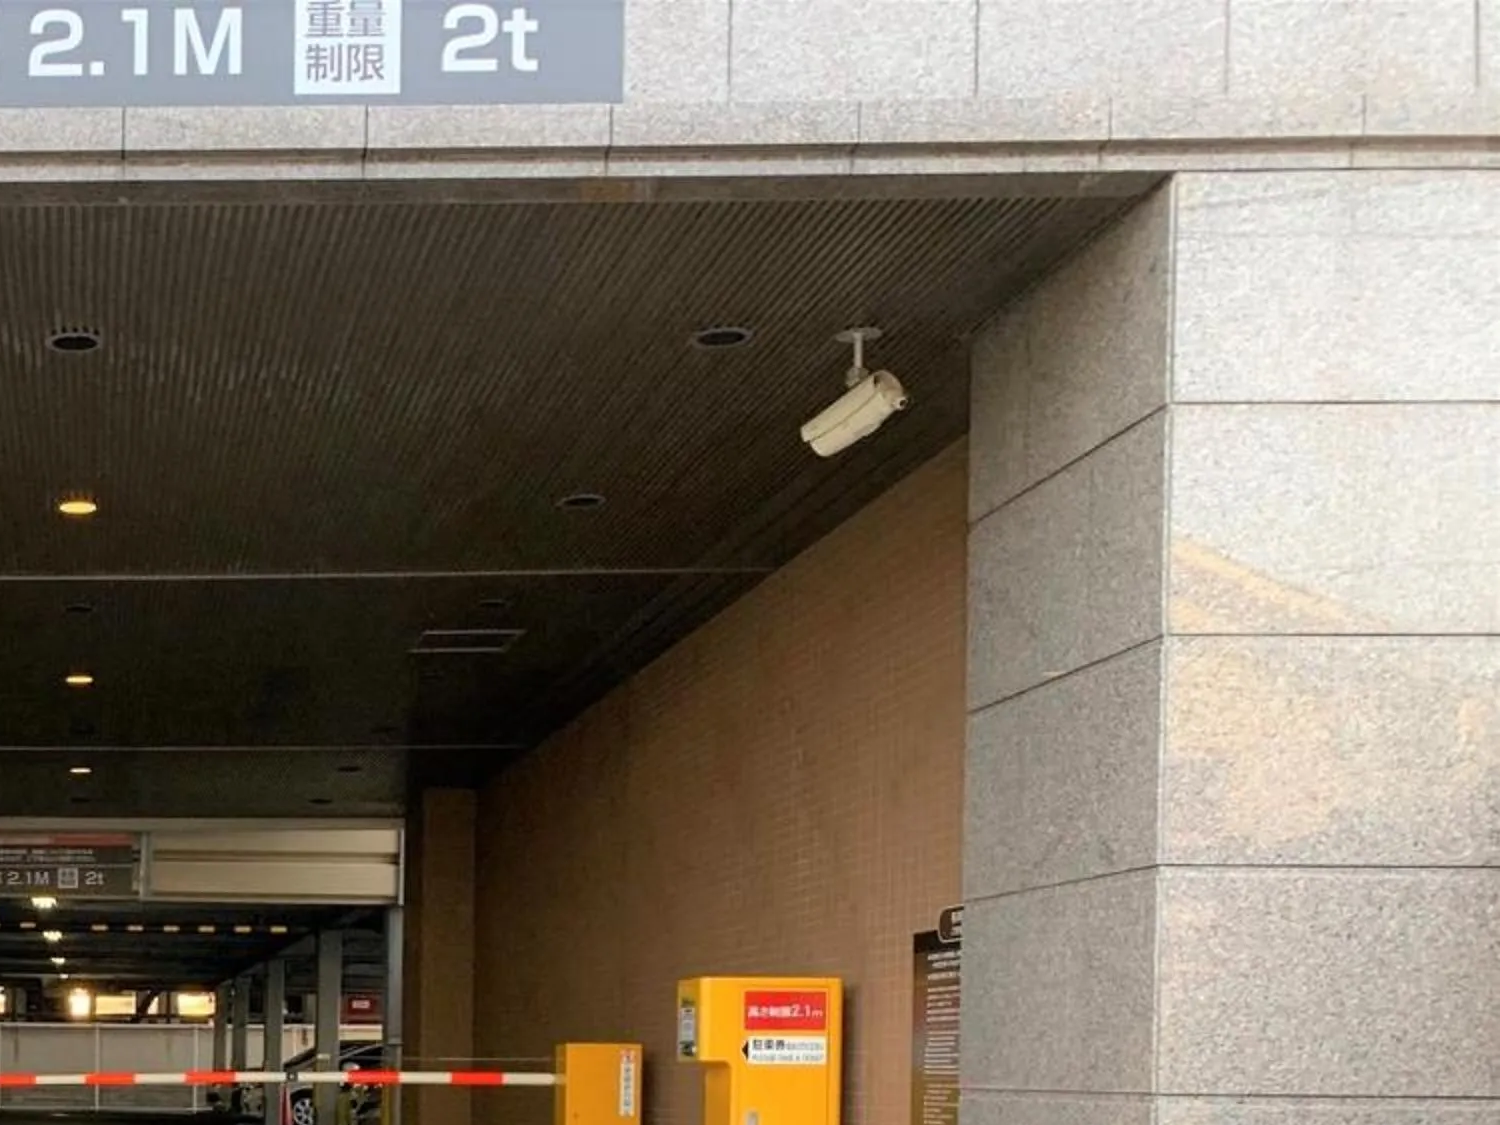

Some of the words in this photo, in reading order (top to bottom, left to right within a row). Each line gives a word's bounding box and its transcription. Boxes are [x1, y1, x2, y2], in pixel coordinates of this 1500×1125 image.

[28, 7, 243, 77] 2.1M
[305, 0, 386, 38] 重量
[441, 3, 539, 72] 2t
[305, 43, 385, 82] 制限
